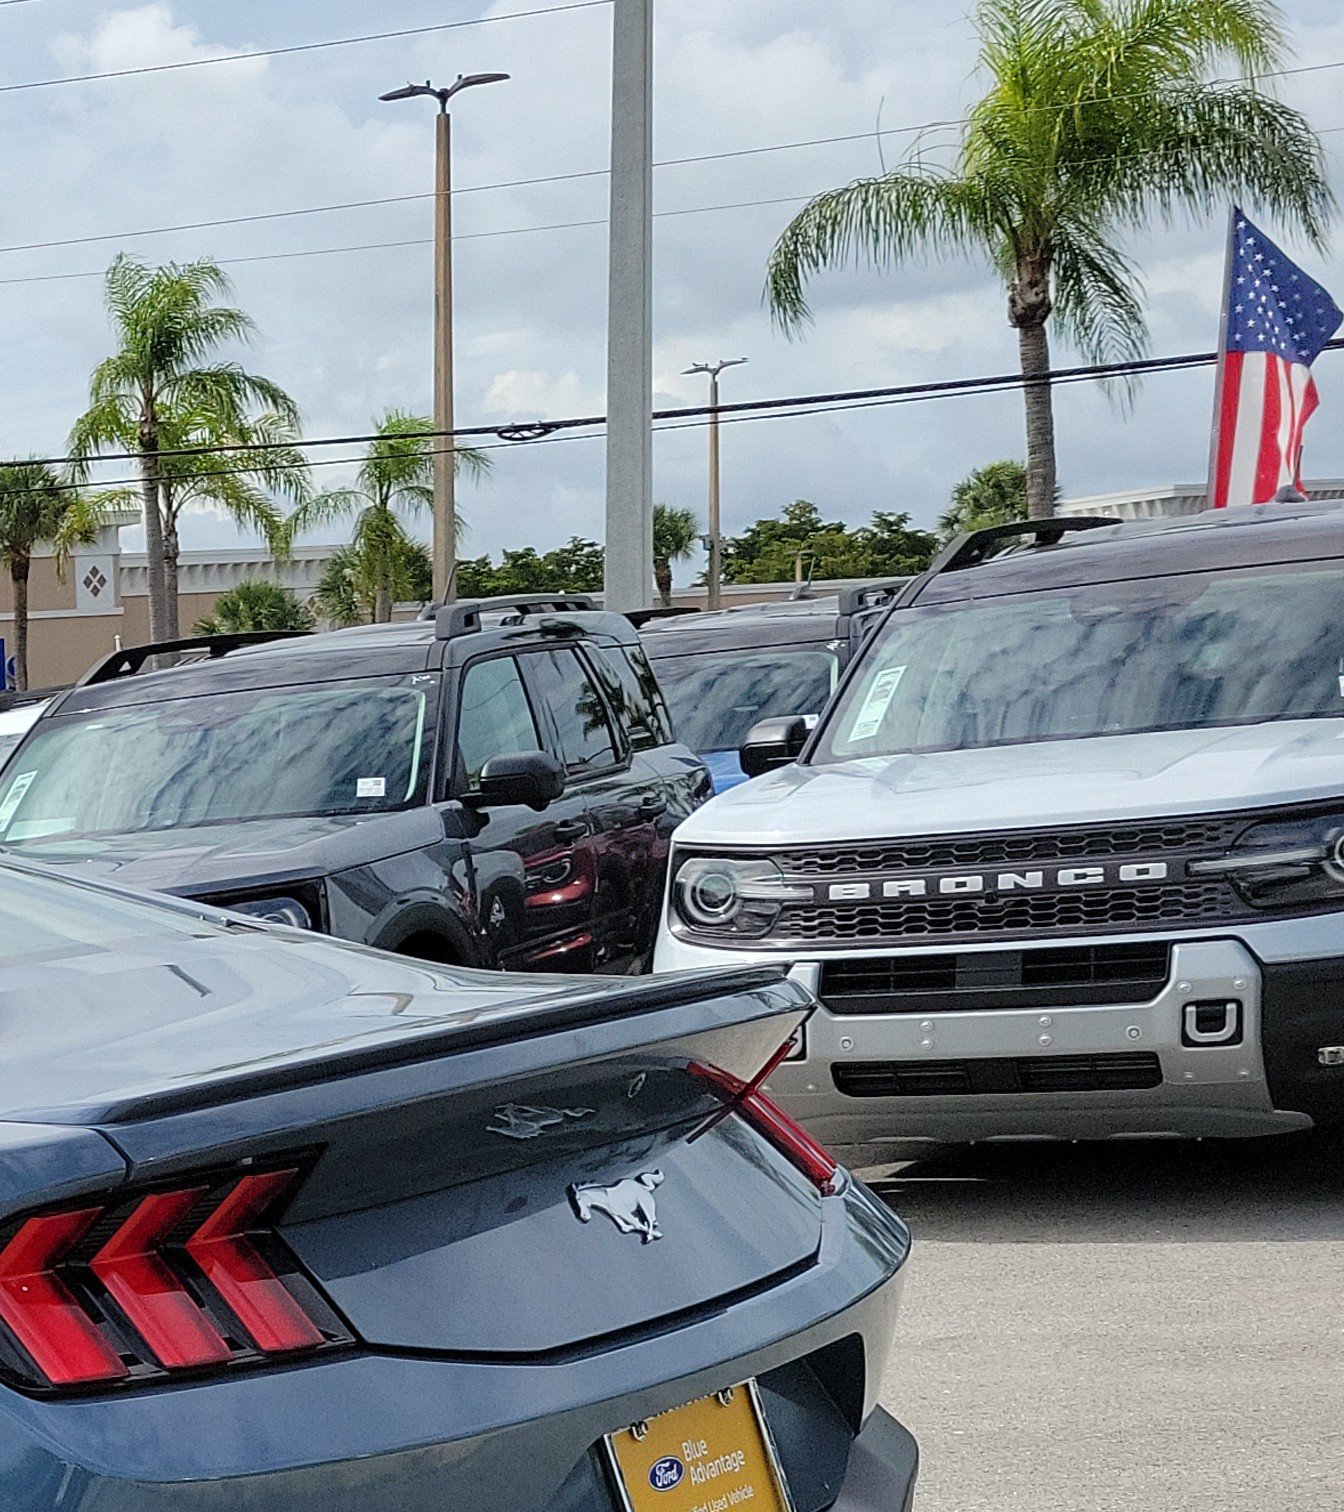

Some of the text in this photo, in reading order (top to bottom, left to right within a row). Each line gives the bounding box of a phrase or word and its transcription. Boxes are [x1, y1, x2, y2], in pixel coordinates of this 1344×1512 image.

[828, 862, 1168, 900] BRONCO
[681, 1438, 708, 1462] Blue
[689, 1449, 746, 1486] Advantage
[726, 1485, 755, 1508] Vehicle
